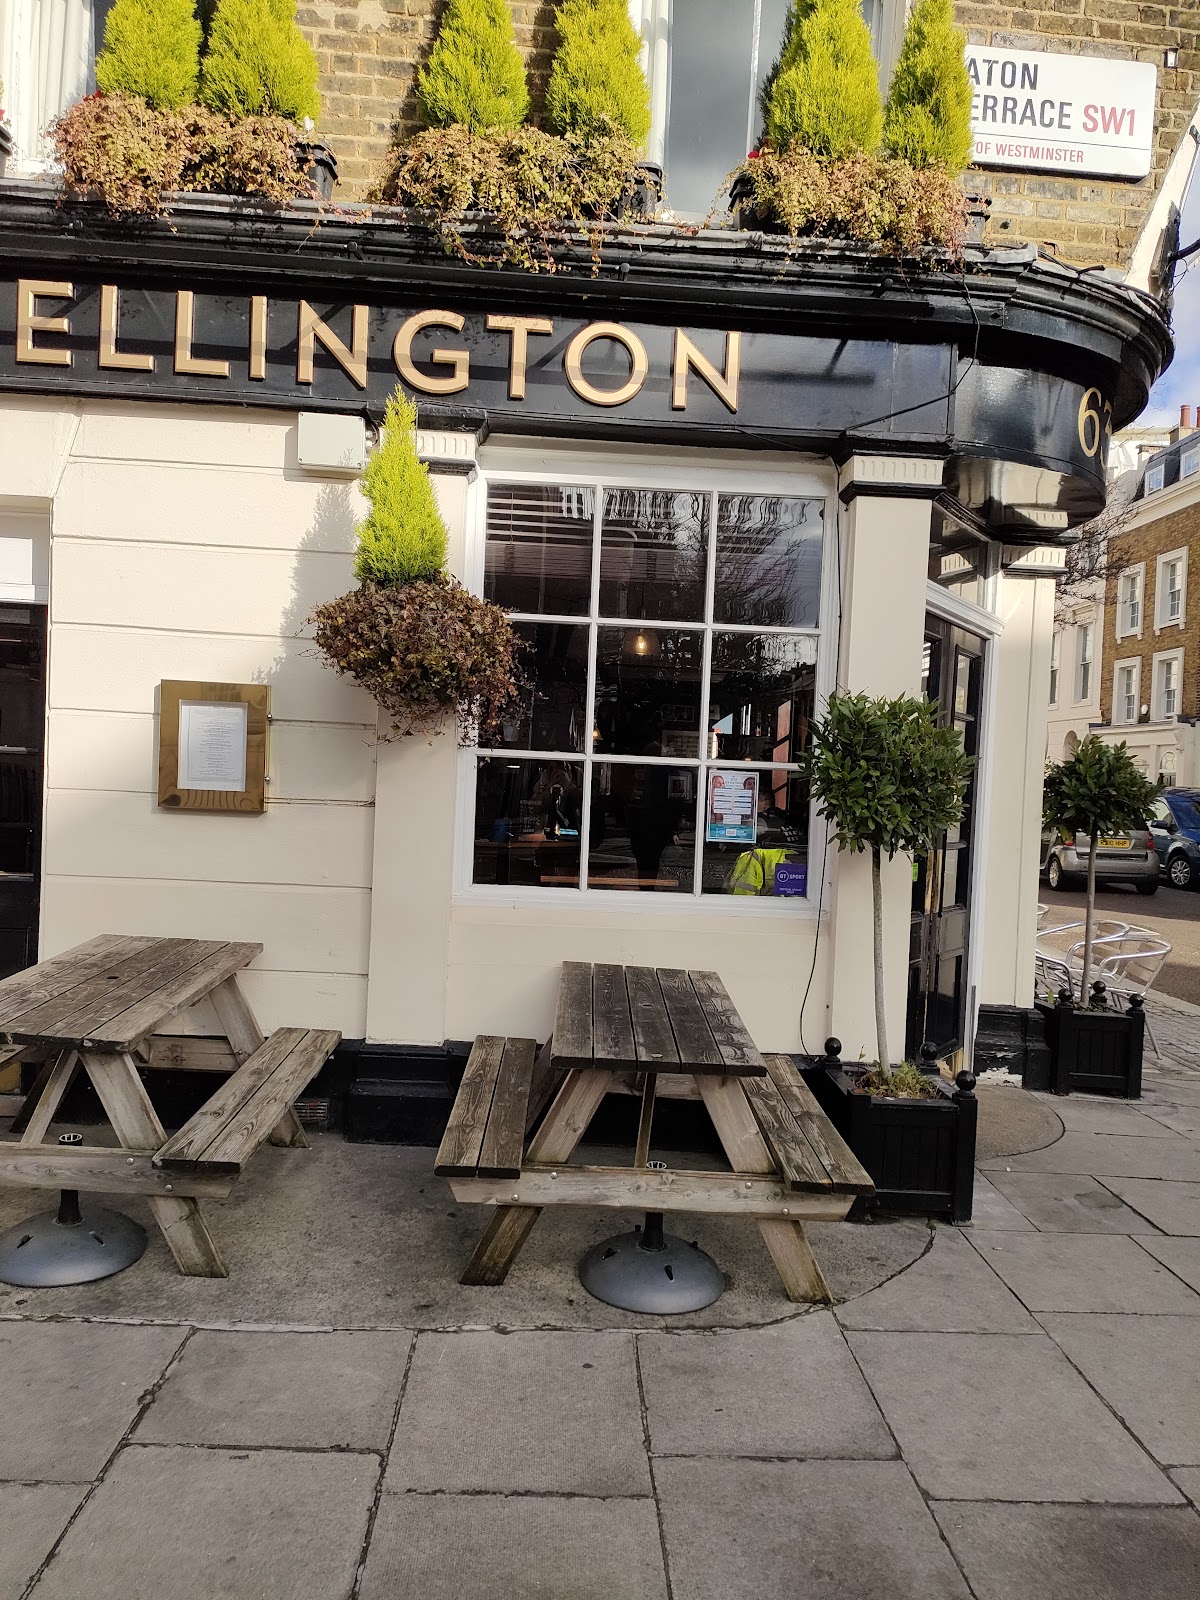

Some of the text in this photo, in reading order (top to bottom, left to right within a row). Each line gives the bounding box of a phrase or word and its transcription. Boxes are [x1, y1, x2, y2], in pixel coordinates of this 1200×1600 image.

[1082, 104, 1136, 137] SW1
[975, 141, 1085, 164] OF WESTMINSTER
[15, 278, 742, 414] ELLINGTON
